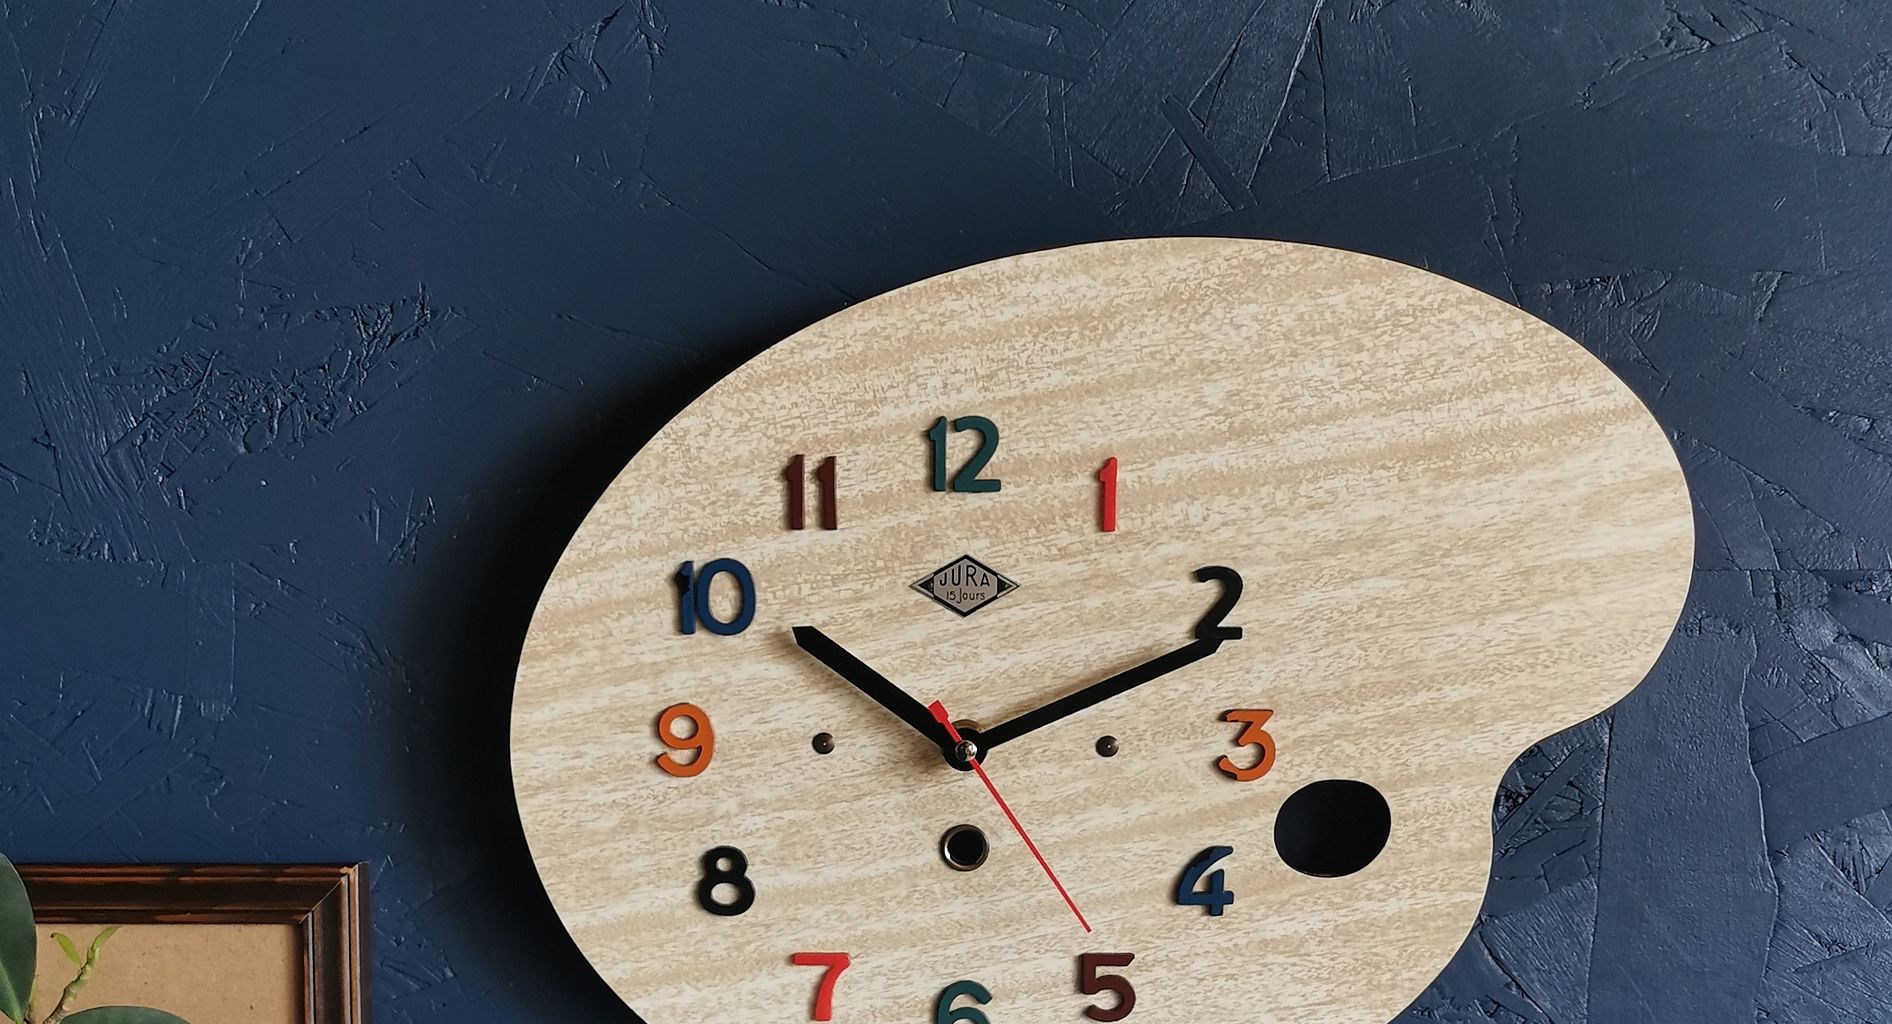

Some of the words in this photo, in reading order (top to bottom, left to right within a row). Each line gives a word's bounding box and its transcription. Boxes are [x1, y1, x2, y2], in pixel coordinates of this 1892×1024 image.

[926, 416, 1001, 492] 12
[783, 453, 838, 530] 11
[1098, 456, 1119, 532] 1
[676, 557, 757, 636] 10
[939, 564, 991, 587] JURA
[946, 590, 957, 601] 15
[1193, 565, 1244, 641] 2
[655, 701, 715, 778] 9
[1217, 708, 1276, 782] 3
[697, 845, 756, 916] 8
[1175, 845, 1235, 917] 4
[789, 951, 851, 1022] 7
[1078, 951, 1137, 1022] 5
